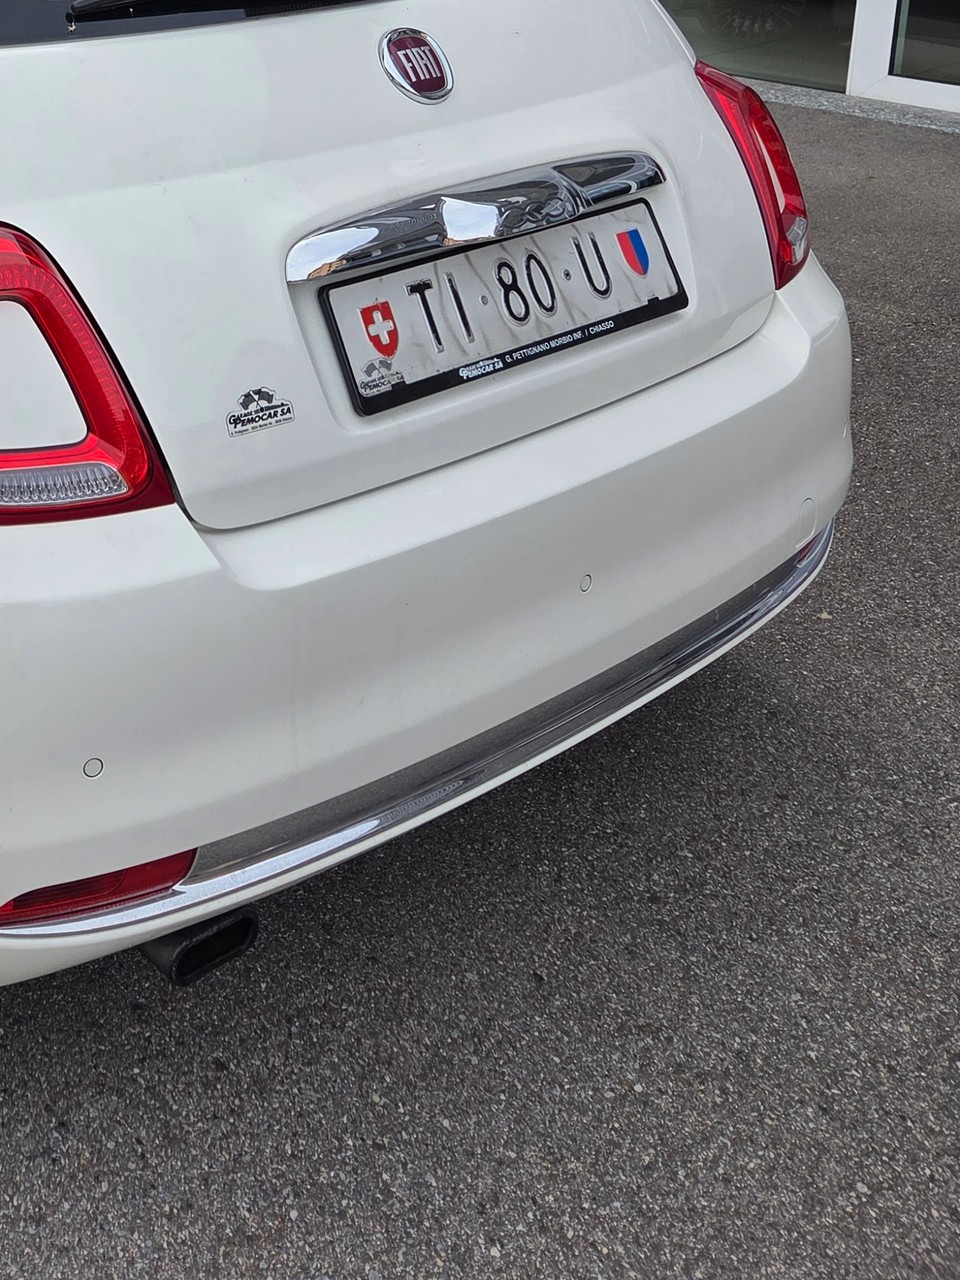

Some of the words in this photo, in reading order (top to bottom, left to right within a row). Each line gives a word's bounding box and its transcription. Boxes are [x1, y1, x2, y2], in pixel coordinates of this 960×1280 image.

[396, 45, 441, 83] FIAT
[495, 252, 558, 324] 80
[571, 231, 612, 299] U
[589, 320, 615, 335] CHIASSO
[234, 409, 279, 429] PEMOCAR
[280, 406, 292, 417] SA
